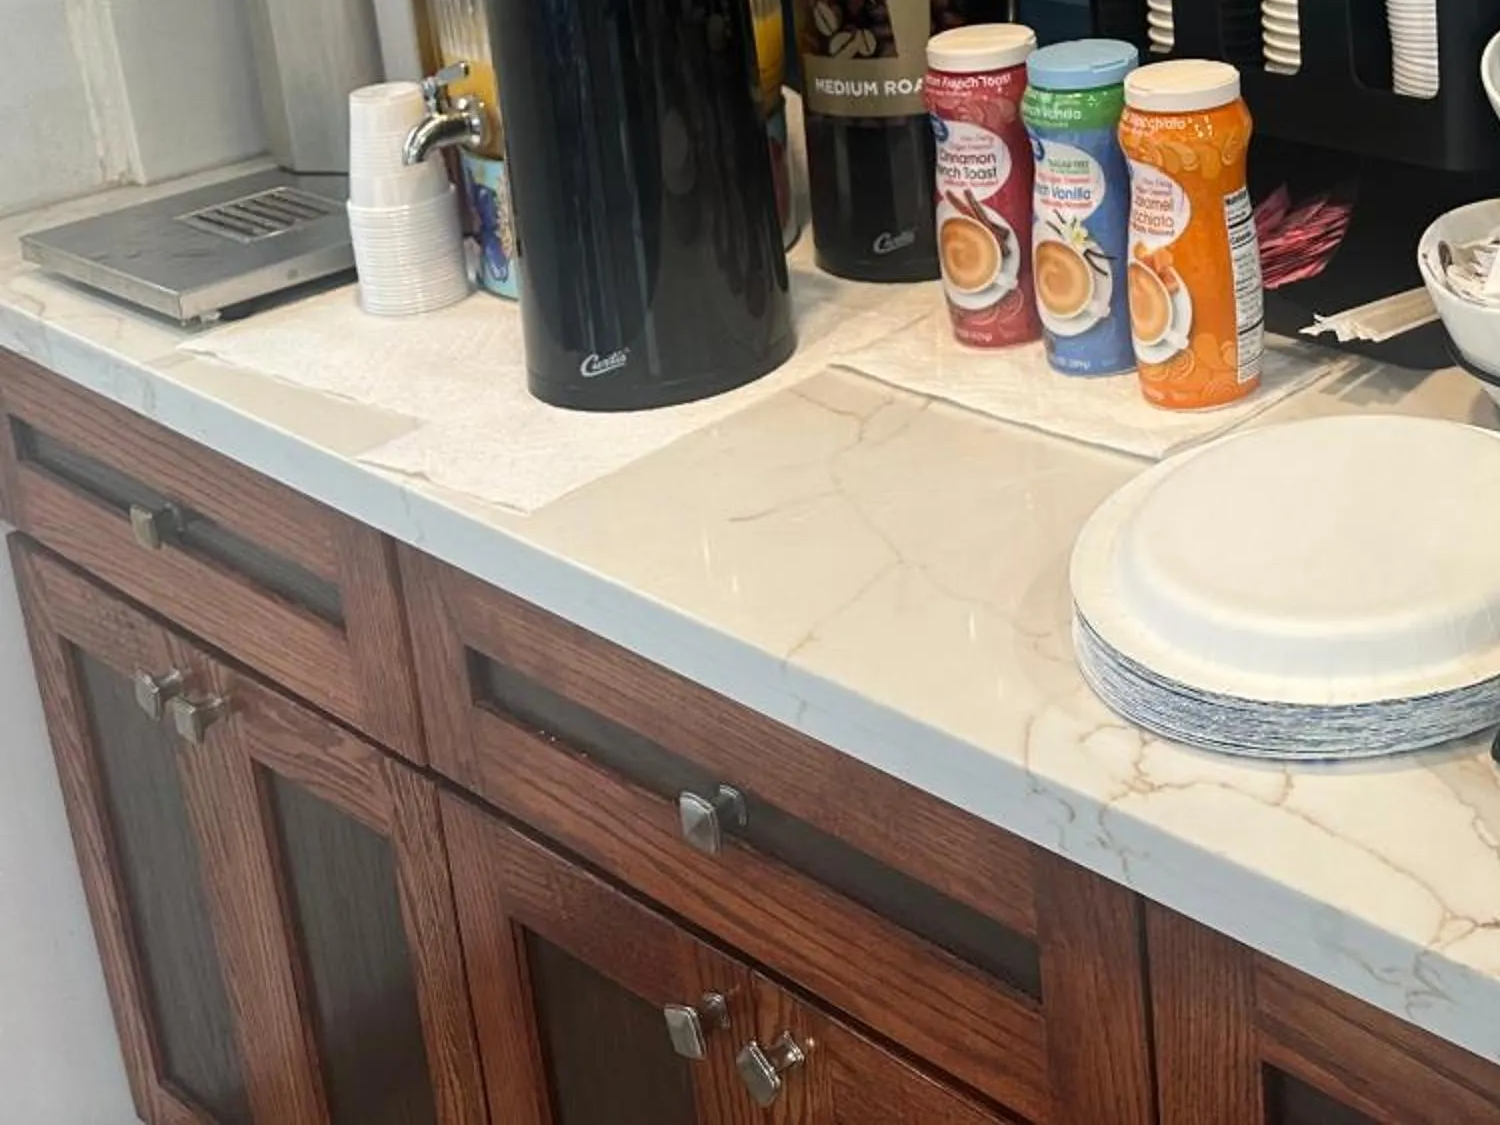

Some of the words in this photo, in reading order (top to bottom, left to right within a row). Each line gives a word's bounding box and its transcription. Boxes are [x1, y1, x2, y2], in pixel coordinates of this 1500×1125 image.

[815, 78, 879, 96] MEDIUM
[884, 78, 924, 97] ROA
[963, 166, 997, 179] Toast
[1051, 186, 1092, 200] Vanilla
